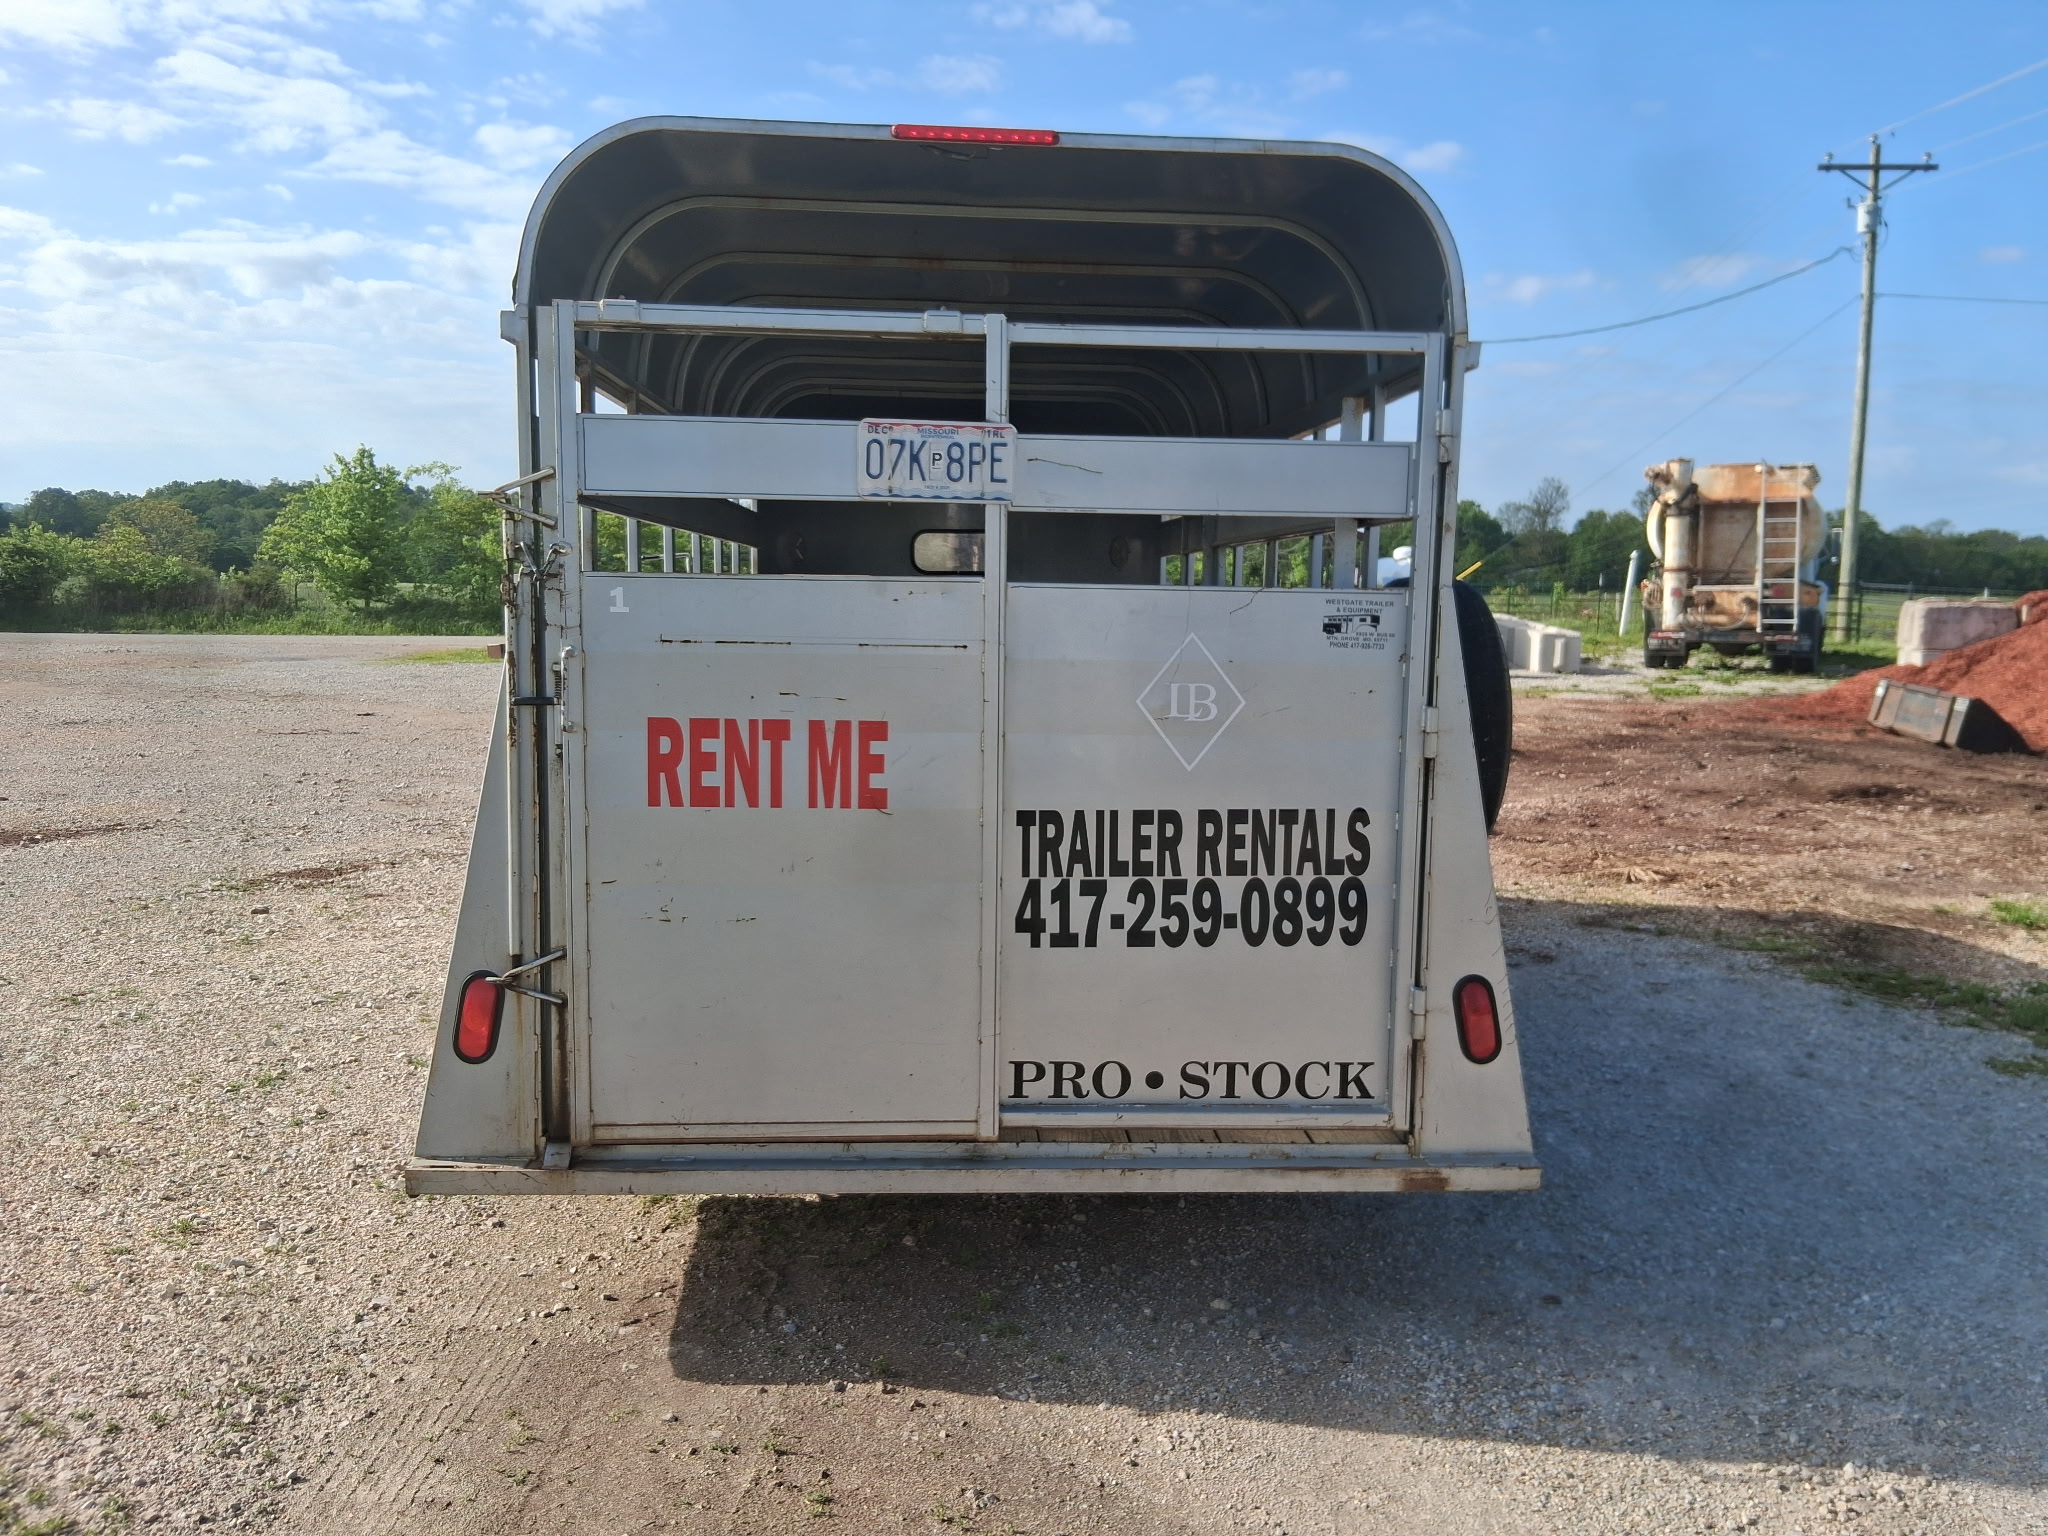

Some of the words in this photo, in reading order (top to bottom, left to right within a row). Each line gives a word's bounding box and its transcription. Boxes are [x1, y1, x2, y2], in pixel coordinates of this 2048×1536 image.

[867, 425, 888, 434] DEC
[917, 427, 959, 436] MISSOURI
[610, 586, 630, 613] 1
[647, 716, 791, 808] RENT
[808, 719, 889, 810] ME
[1016, 809, 1183, 878] TRAILER
[1197, 807, 1371, 877] RENTALS
[1014, 876, 1368, 949] 417-259-0899
[1008, 1060, 1132, 1099] PRO
[1179, 1060, 1375, 1100] STOCK
